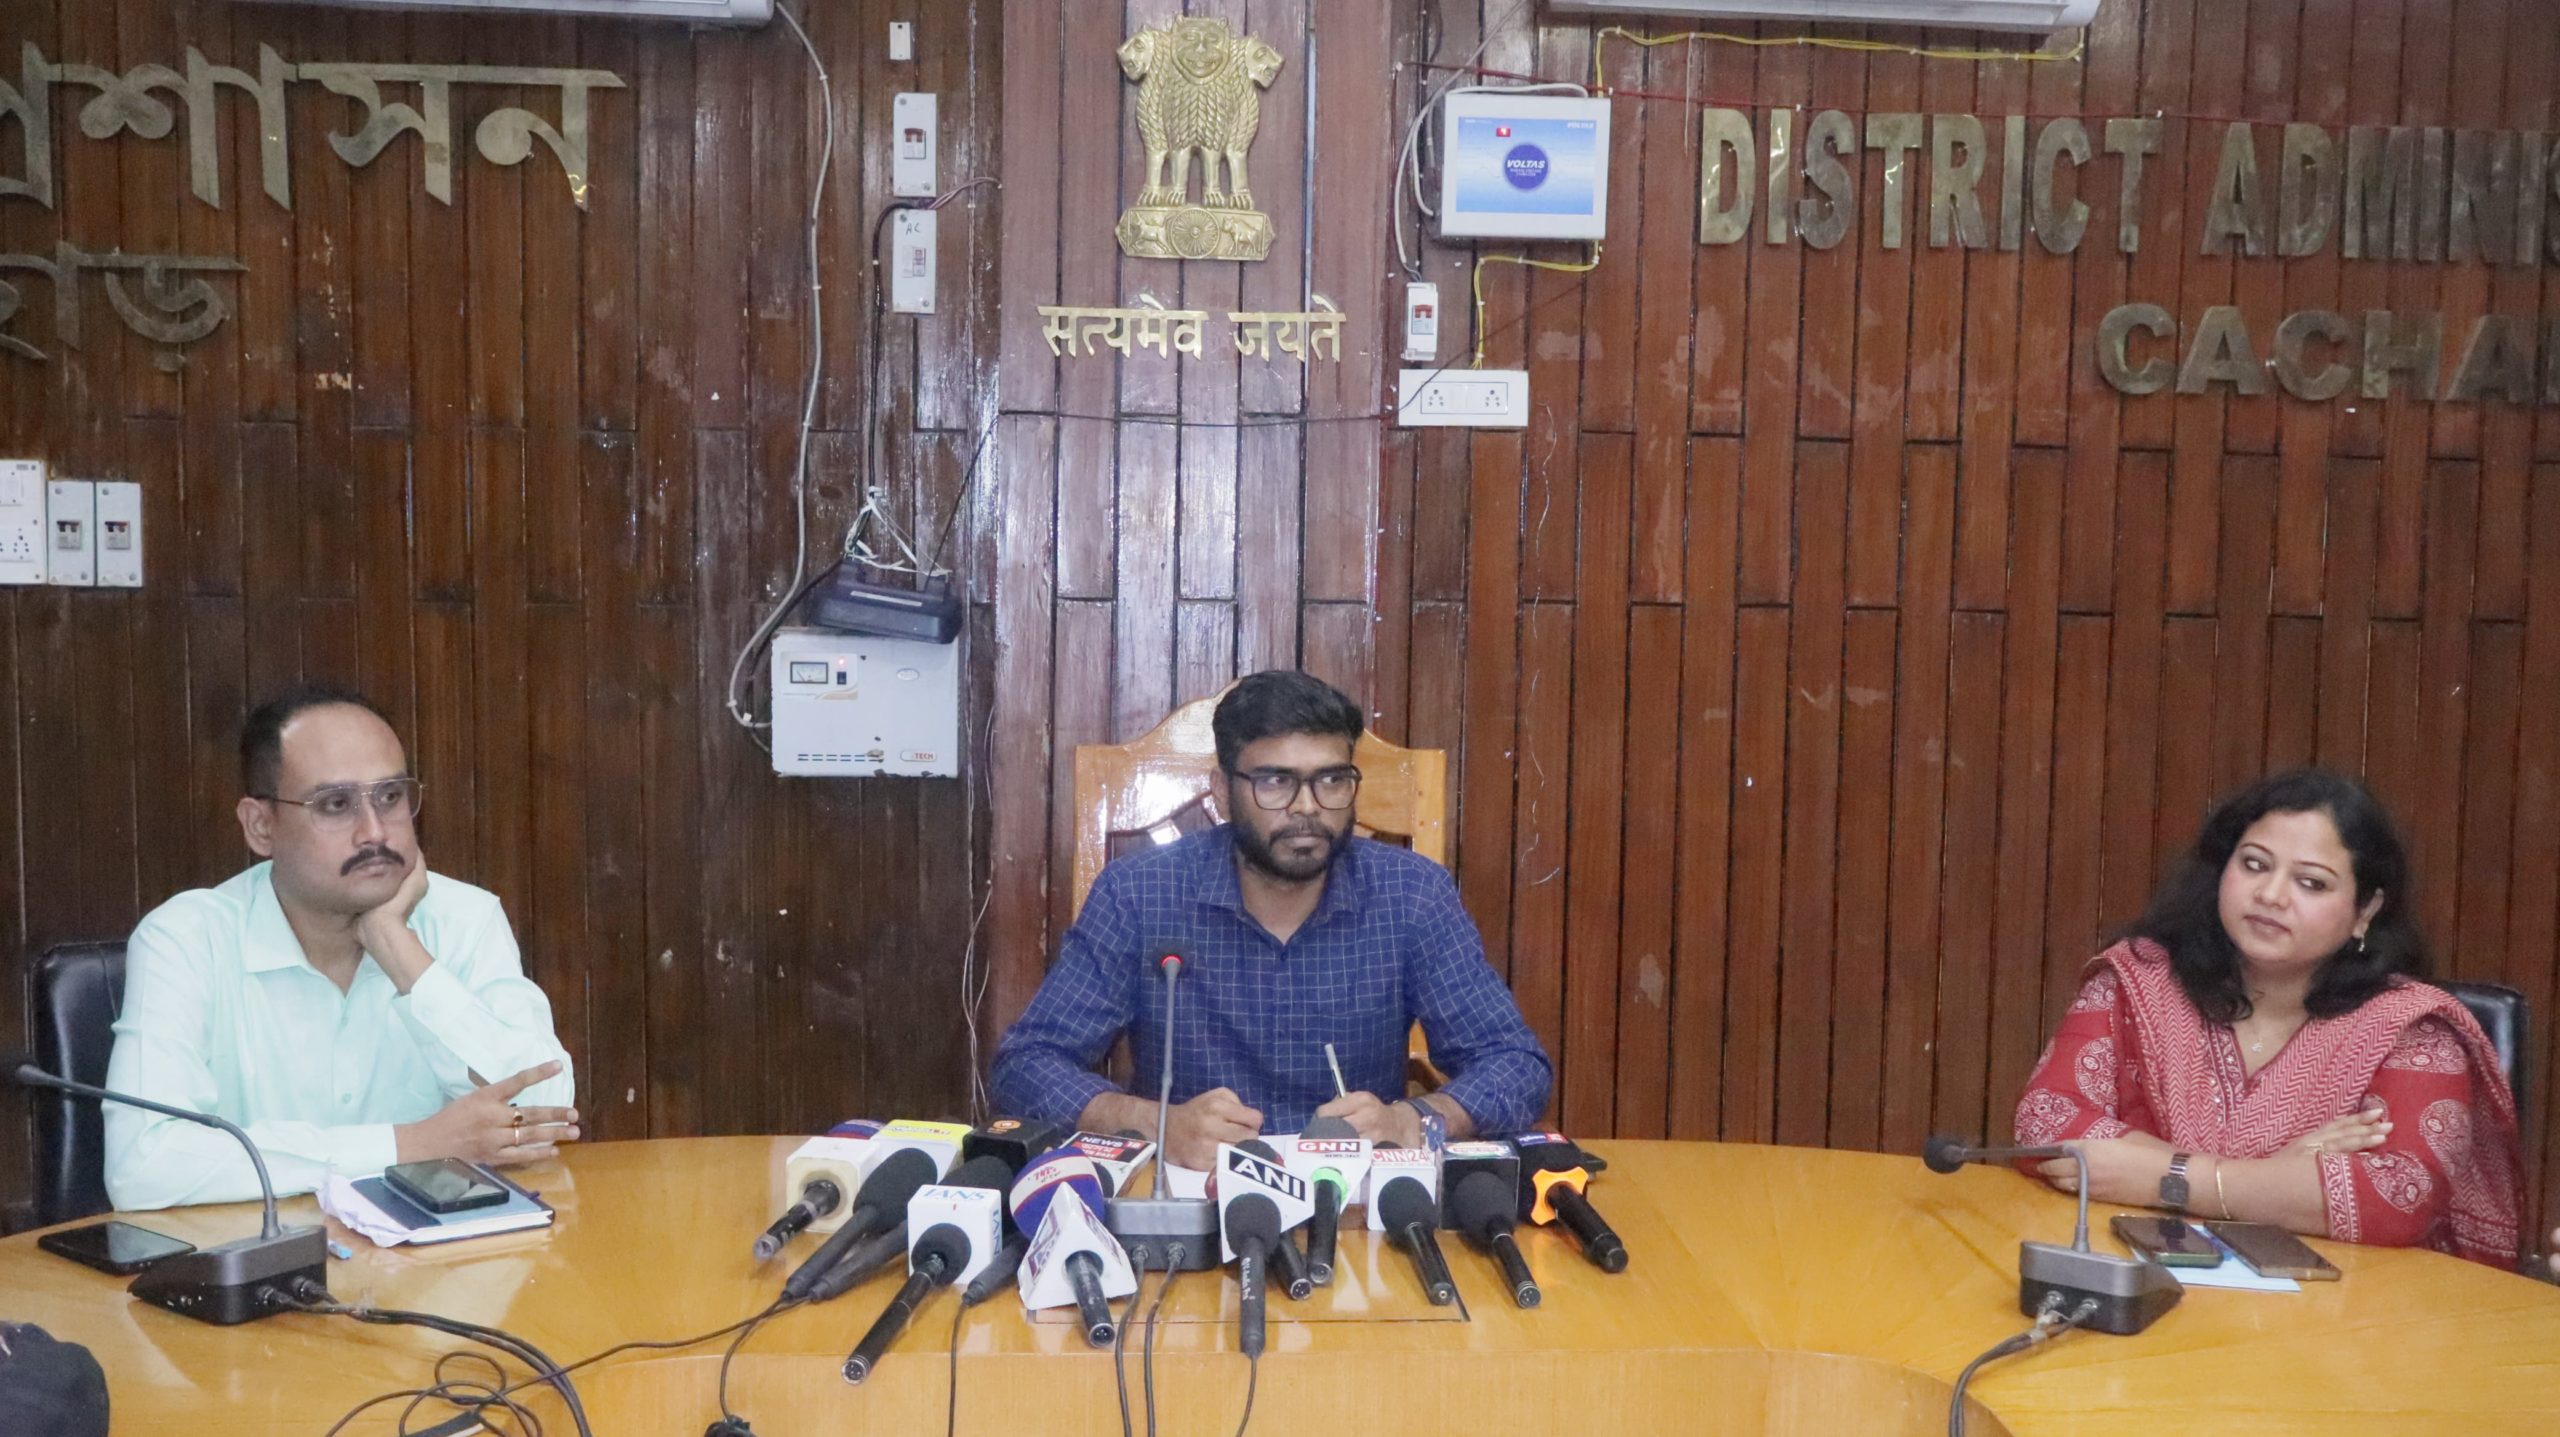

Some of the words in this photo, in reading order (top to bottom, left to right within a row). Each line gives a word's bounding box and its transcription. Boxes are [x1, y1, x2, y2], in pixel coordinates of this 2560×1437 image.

[1507, 160, 1545, 169] VOLTAS
[1700, 107, 2164, 255] DISTRICT
[2201, 121, 2560, 266] ADMINI
[1037, 293, 1209, 360] सत्यमेव
[1228, 294, 1346, 362] जयते
[2097, 302, 2560, 404] CACHA
[1080, 1136, 1124, 1148] NEWS
[1299, 1141, 1358, 1152] GNN
[1372, 1149, 1428, 1163] CNN24
[1234, 1157, 1301, 1199] ANI
[923, 1187, 985, 1201] IANS
